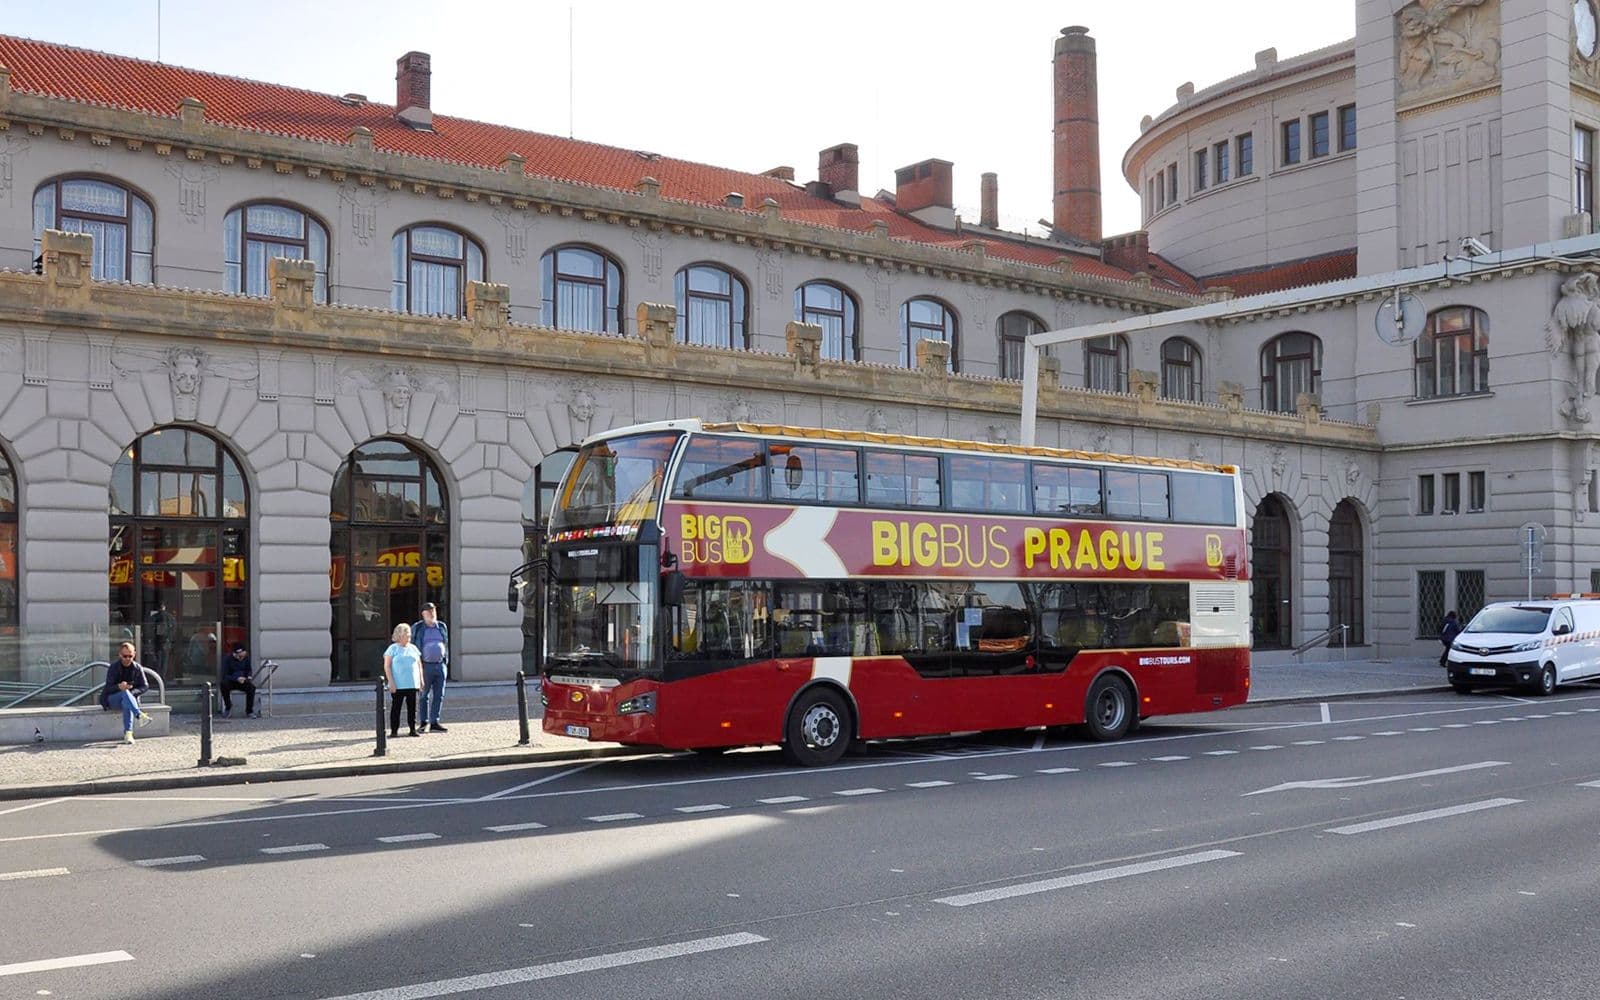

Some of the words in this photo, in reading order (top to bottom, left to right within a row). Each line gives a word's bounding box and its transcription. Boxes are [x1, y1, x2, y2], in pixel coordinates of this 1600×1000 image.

[681, 514, 721, 540] BIG
[682, 541, 722, 563] BUS
[872, 520, 1010, 568] BIGBUS
[1024, 527, 1165, 571] PRAGUE
